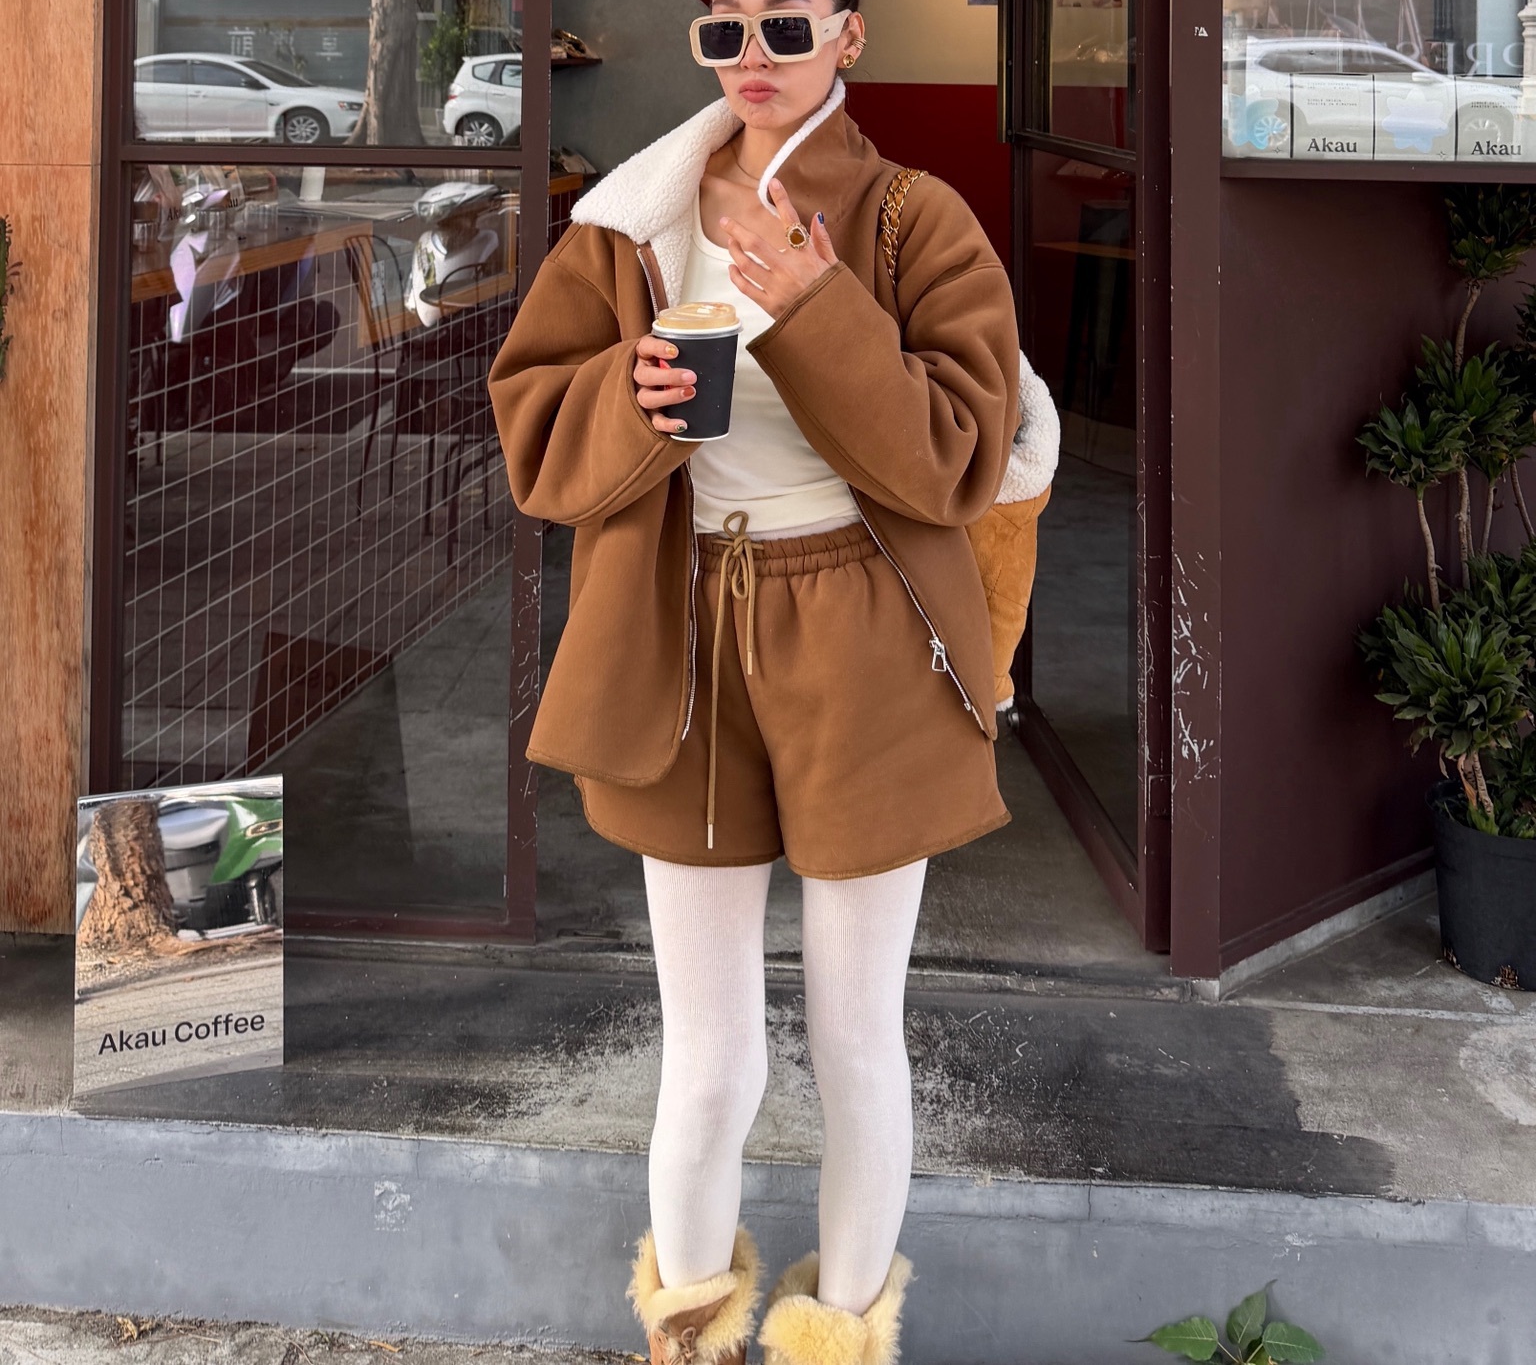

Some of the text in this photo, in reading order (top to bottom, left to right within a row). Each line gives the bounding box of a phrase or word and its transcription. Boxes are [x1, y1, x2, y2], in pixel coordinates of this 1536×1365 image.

[1307, 137, 1358, 153] Akau
[1471, 140, 1522, 155] Akau
[98, 1012, 266, 1055] Akau Coffee
